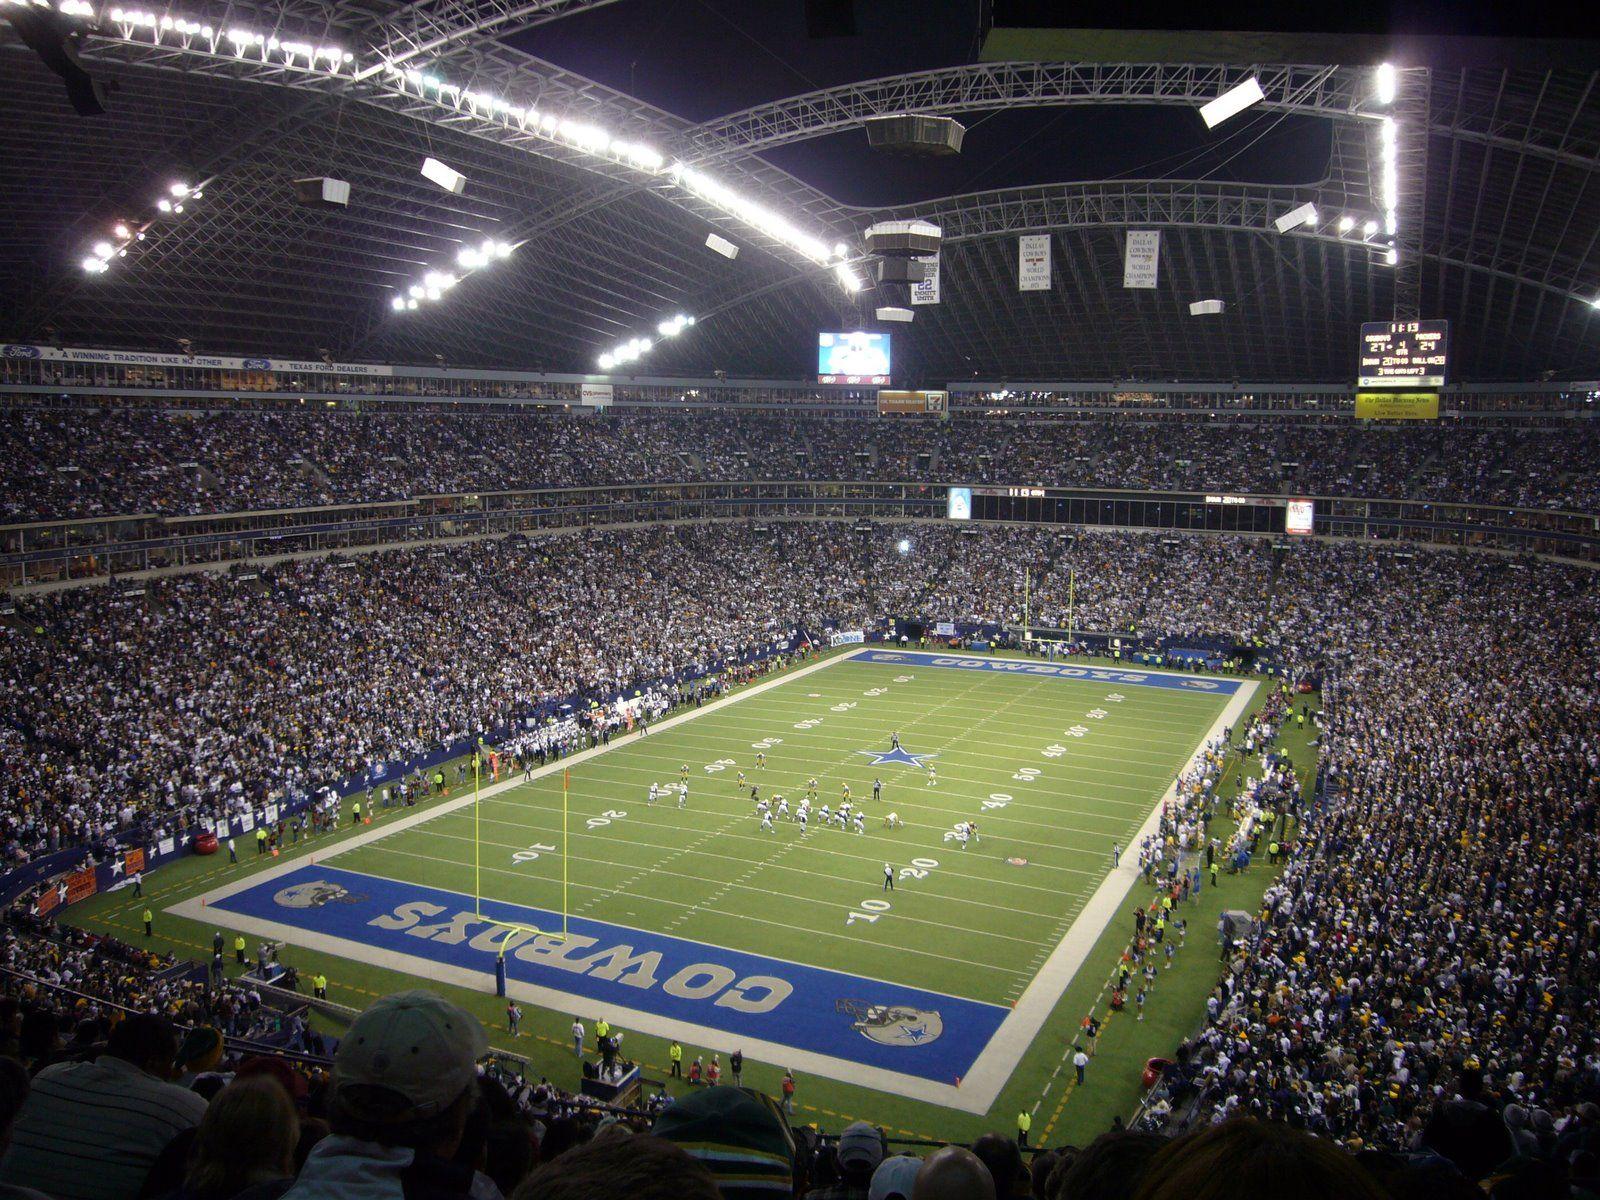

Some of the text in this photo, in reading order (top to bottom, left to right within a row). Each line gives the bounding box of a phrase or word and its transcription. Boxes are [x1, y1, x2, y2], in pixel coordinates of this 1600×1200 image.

[1391, 323, 1419, 333] 11:13
[1370, 342, 1385, 352] 27
[1399, 341, 1406, 349] 4
[1420, 341, 1435, 350] 24
[10, 346, 32, 357] Ford
[72, 352, 110, 360] WINNING
[114, 354, 157, 363] TRADITION
[247, 359, 266, 369] Ford
[289, 363, 368, 373] TEXAS FORD DEALERS
[931, 658, 1148, 682] COWBOYS
[1086, 708, 1108, 719] 20
[1064, 725, 1088, 737] 30
[751, 737, 783, 749] 50
[1040, 745, 1067, 757] 40
[704, 758, 736, 771] 40
[1012, 767, 1041, 781] 50
[982, 793, 1013, 808] 40
[586, 810, 627, 826] 20
[512, 843, 556, 861] 10
[899, 858, 939, 879] 20
[848, 899, 891, 923] 10
[367, 901, 793, 1013] COWBOYS
